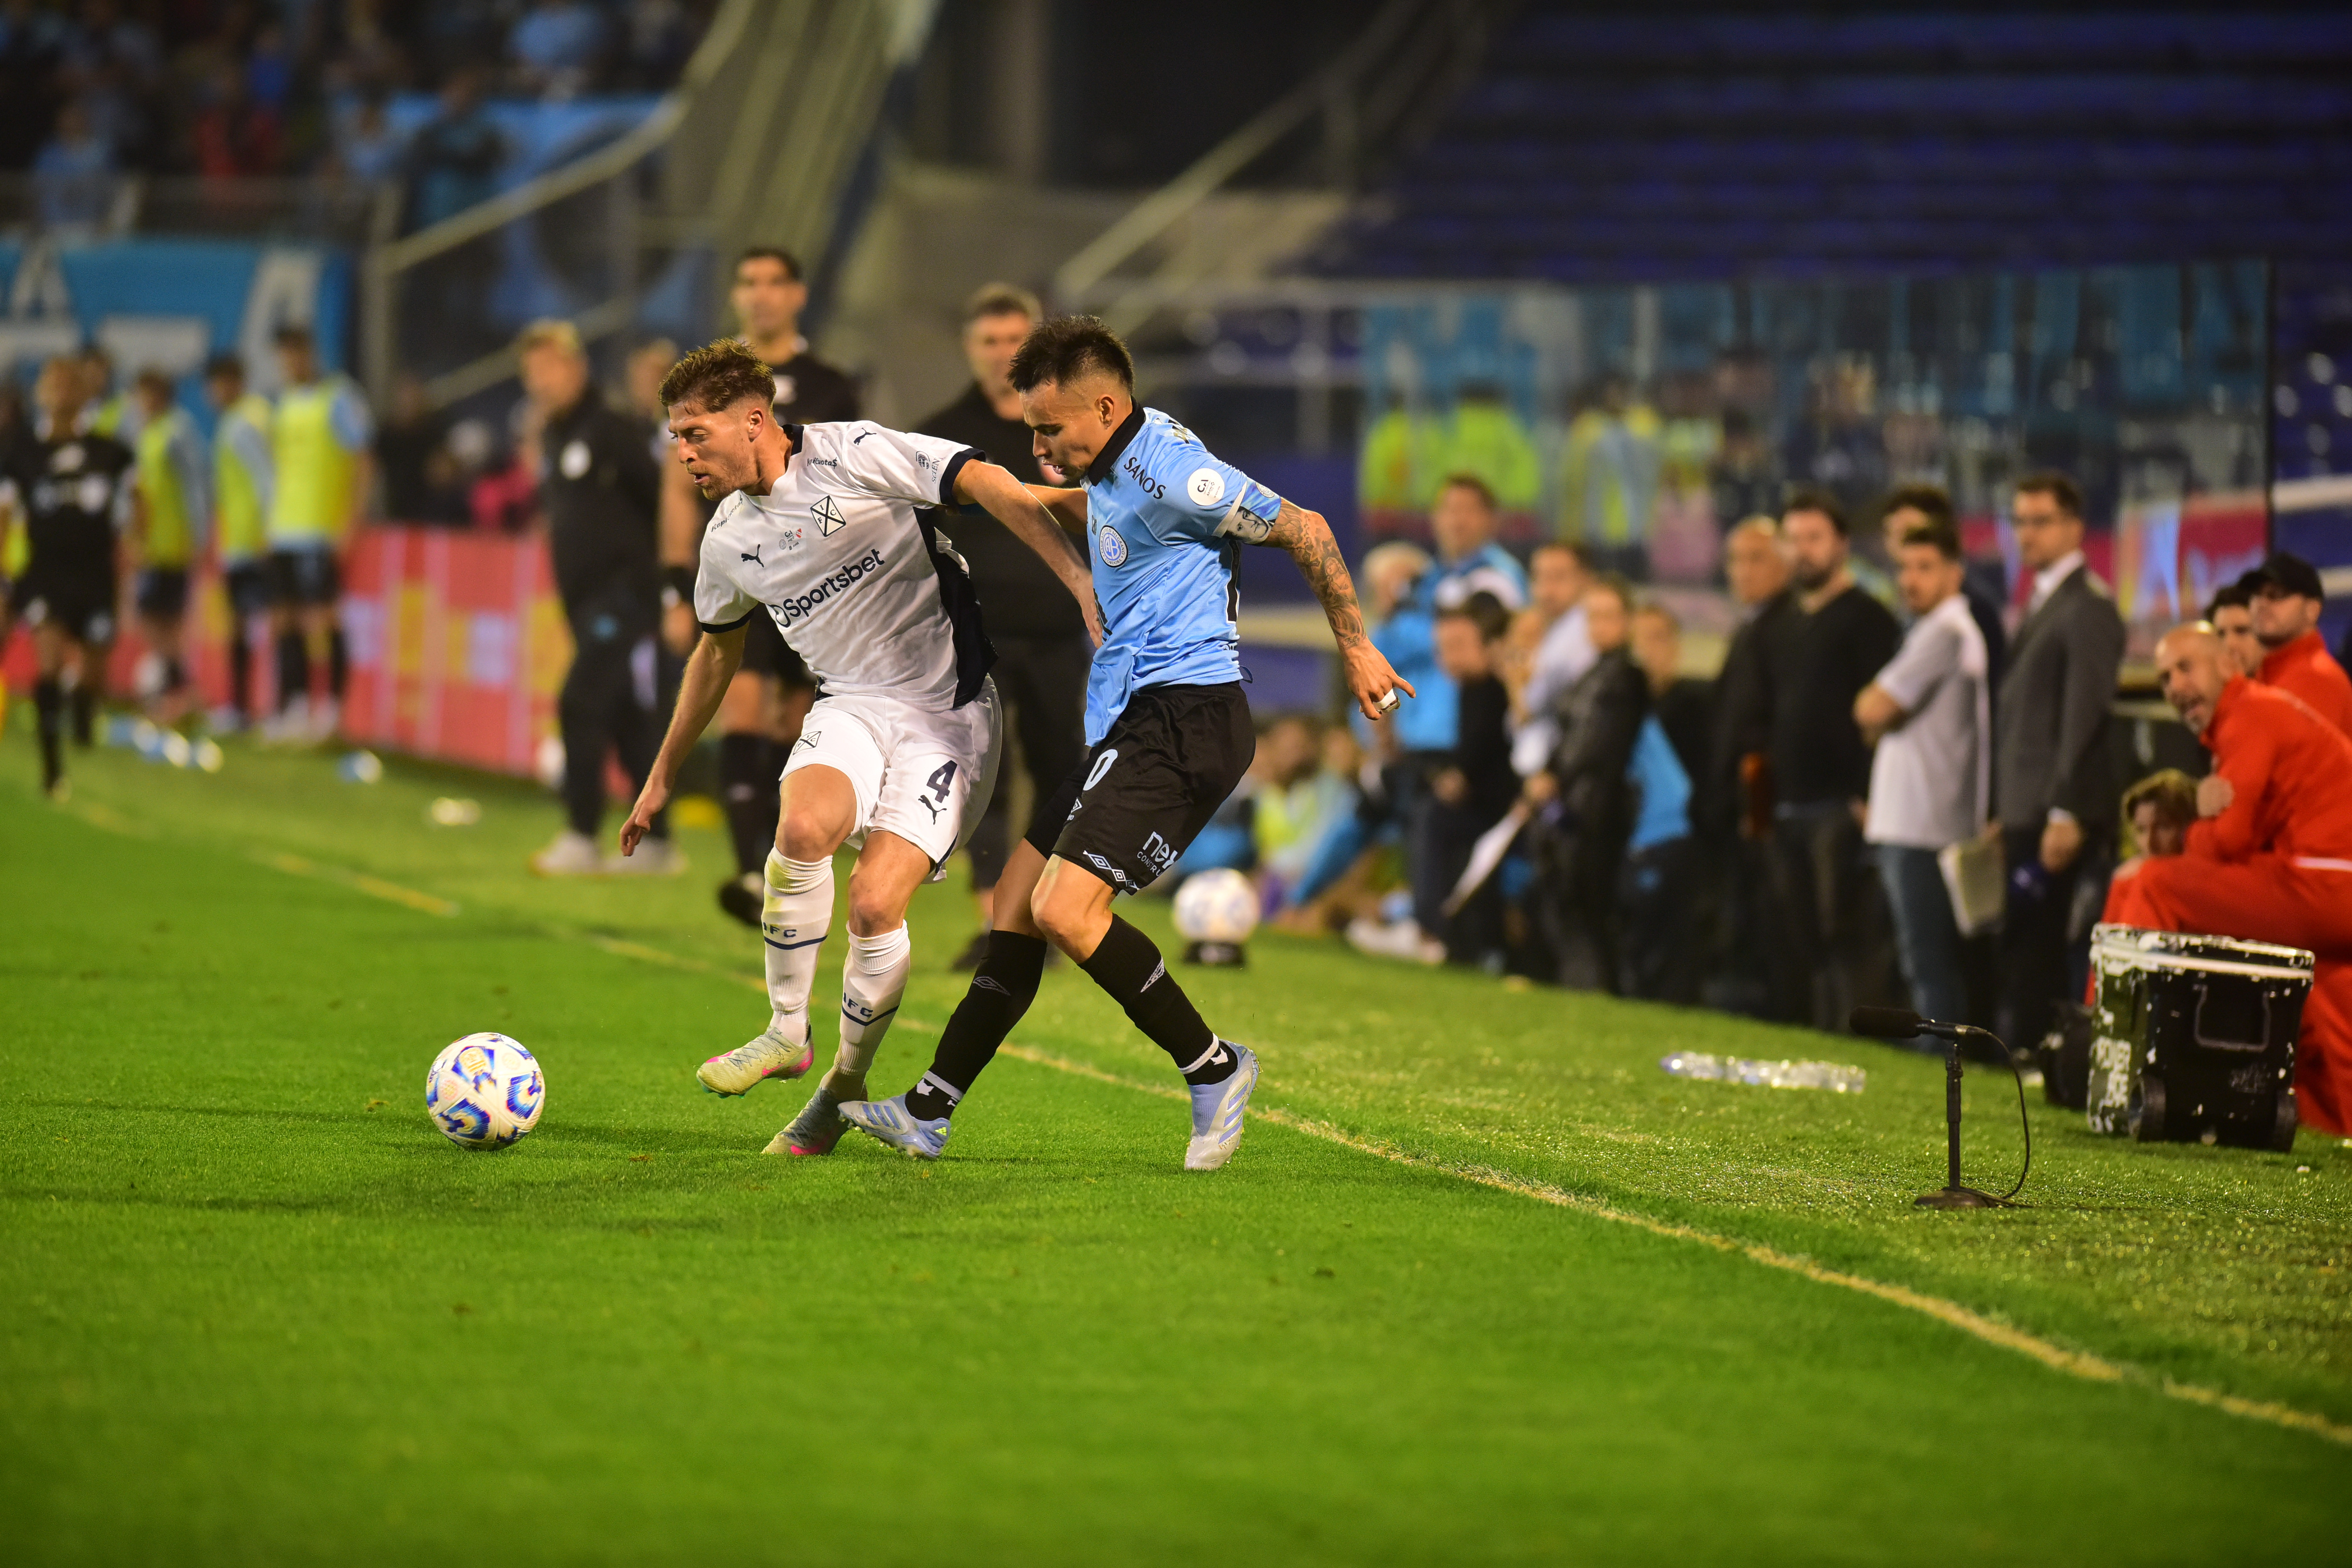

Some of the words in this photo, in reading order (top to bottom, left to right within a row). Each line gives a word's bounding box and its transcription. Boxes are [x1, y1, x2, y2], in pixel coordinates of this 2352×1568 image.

[1124, 457, 1167, 499] SANOS
[1112, 530, 1125, 555] BELGRANO
[783, 549, 885, 617] Sportsbet
[926, 760, 958, 804] 4
